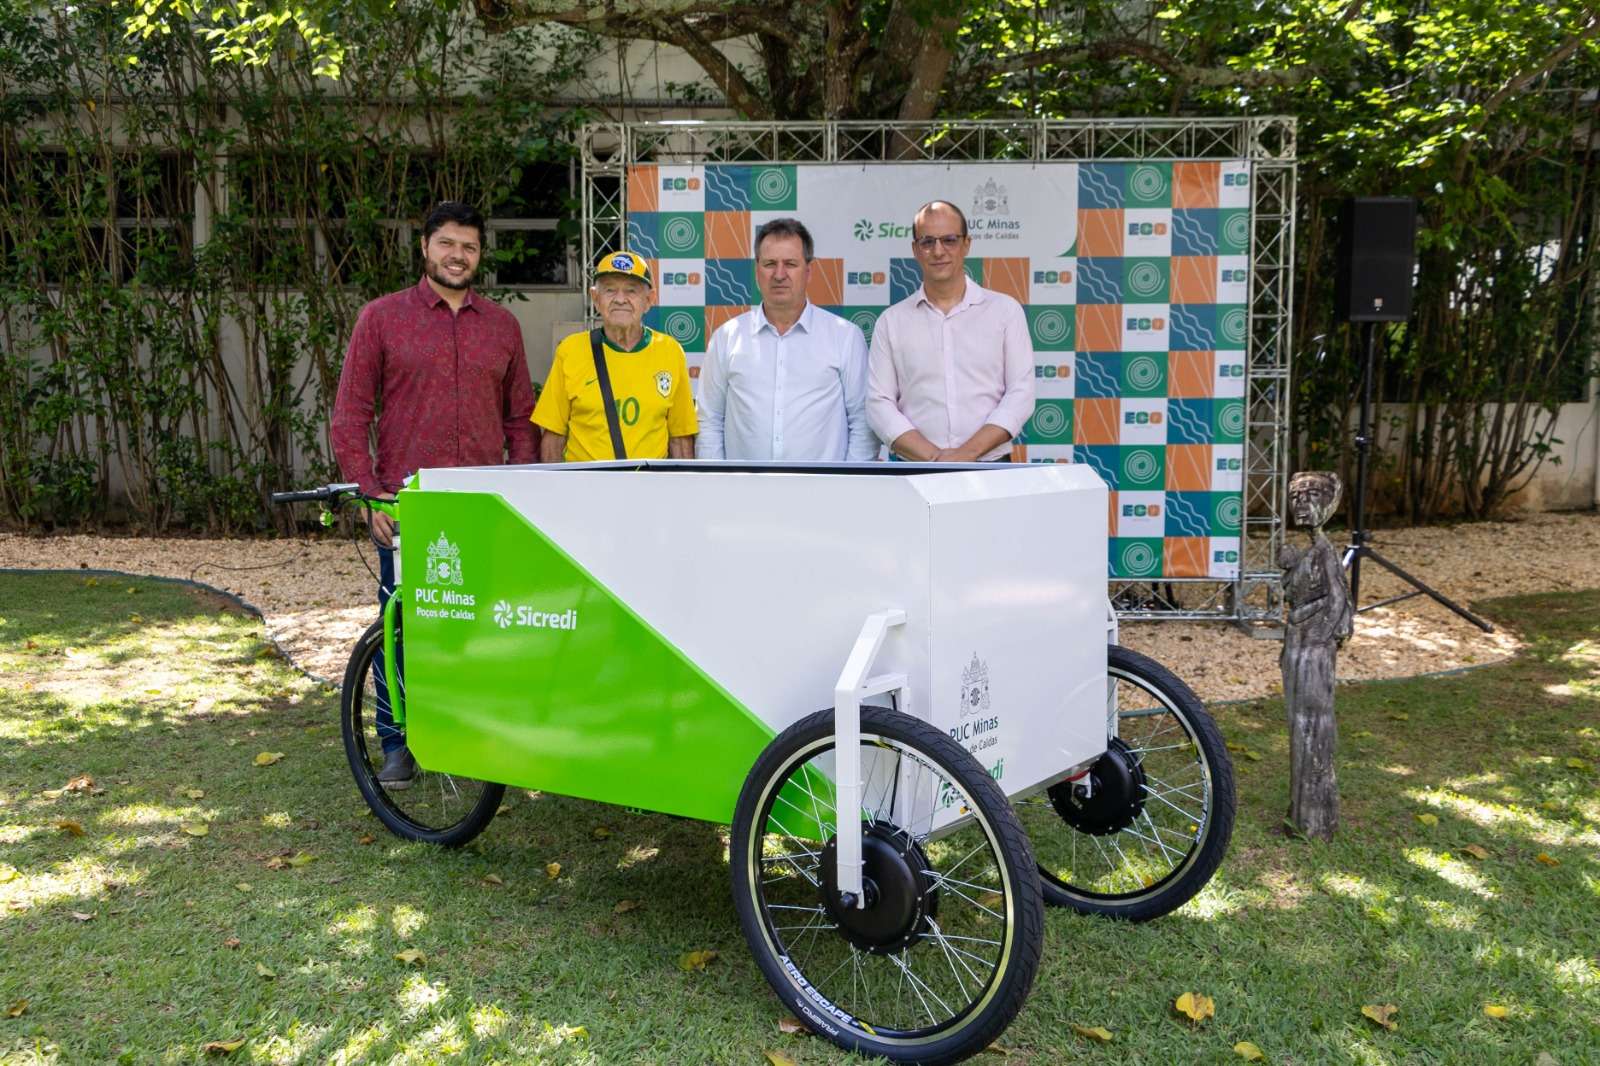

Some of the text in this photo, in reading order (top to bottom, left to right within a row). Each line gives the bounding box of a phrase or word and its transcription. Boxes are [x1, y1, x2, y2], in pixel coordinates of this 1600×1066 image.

[662, 178, 700, 191] ECO
[1223, 173, 1248, 186] EC
[878, 222, 912, 238] Sicr
[968, 218, 1020, 230] UC Minas
[1129, 223, 1167, 236] ECO
[995, 231, 1019, 240] Caldas
[663, 272, 700, 285] ECO
[847, 271, 886, 285] ECO
[1033, 271, 1072, 284] ECO
[1221, 270, 1246, 282] EC
[1126, 318, 1164, 331] ECO
[1035, 366, 1070, 378] ECO
[1219, 365, 1243, 377] EC
[1124, 412, 1162, 424] ECO
[1216, 458, 1241, 470] EC
[1122, 504, 1160, 517] ECO
[1213, 551, 1238, 563] EC
[415, 588, 476, 606] PUC Minas
[416, 606, 476, 620] Poços de Caldas
[516, 605, 577, 630] Sicredi
[950, 716, 998, 742] PUC Minas
[979, 736, 998, 751] Caldas
[779, 954, 853, 1024] AERO ESCAPE
